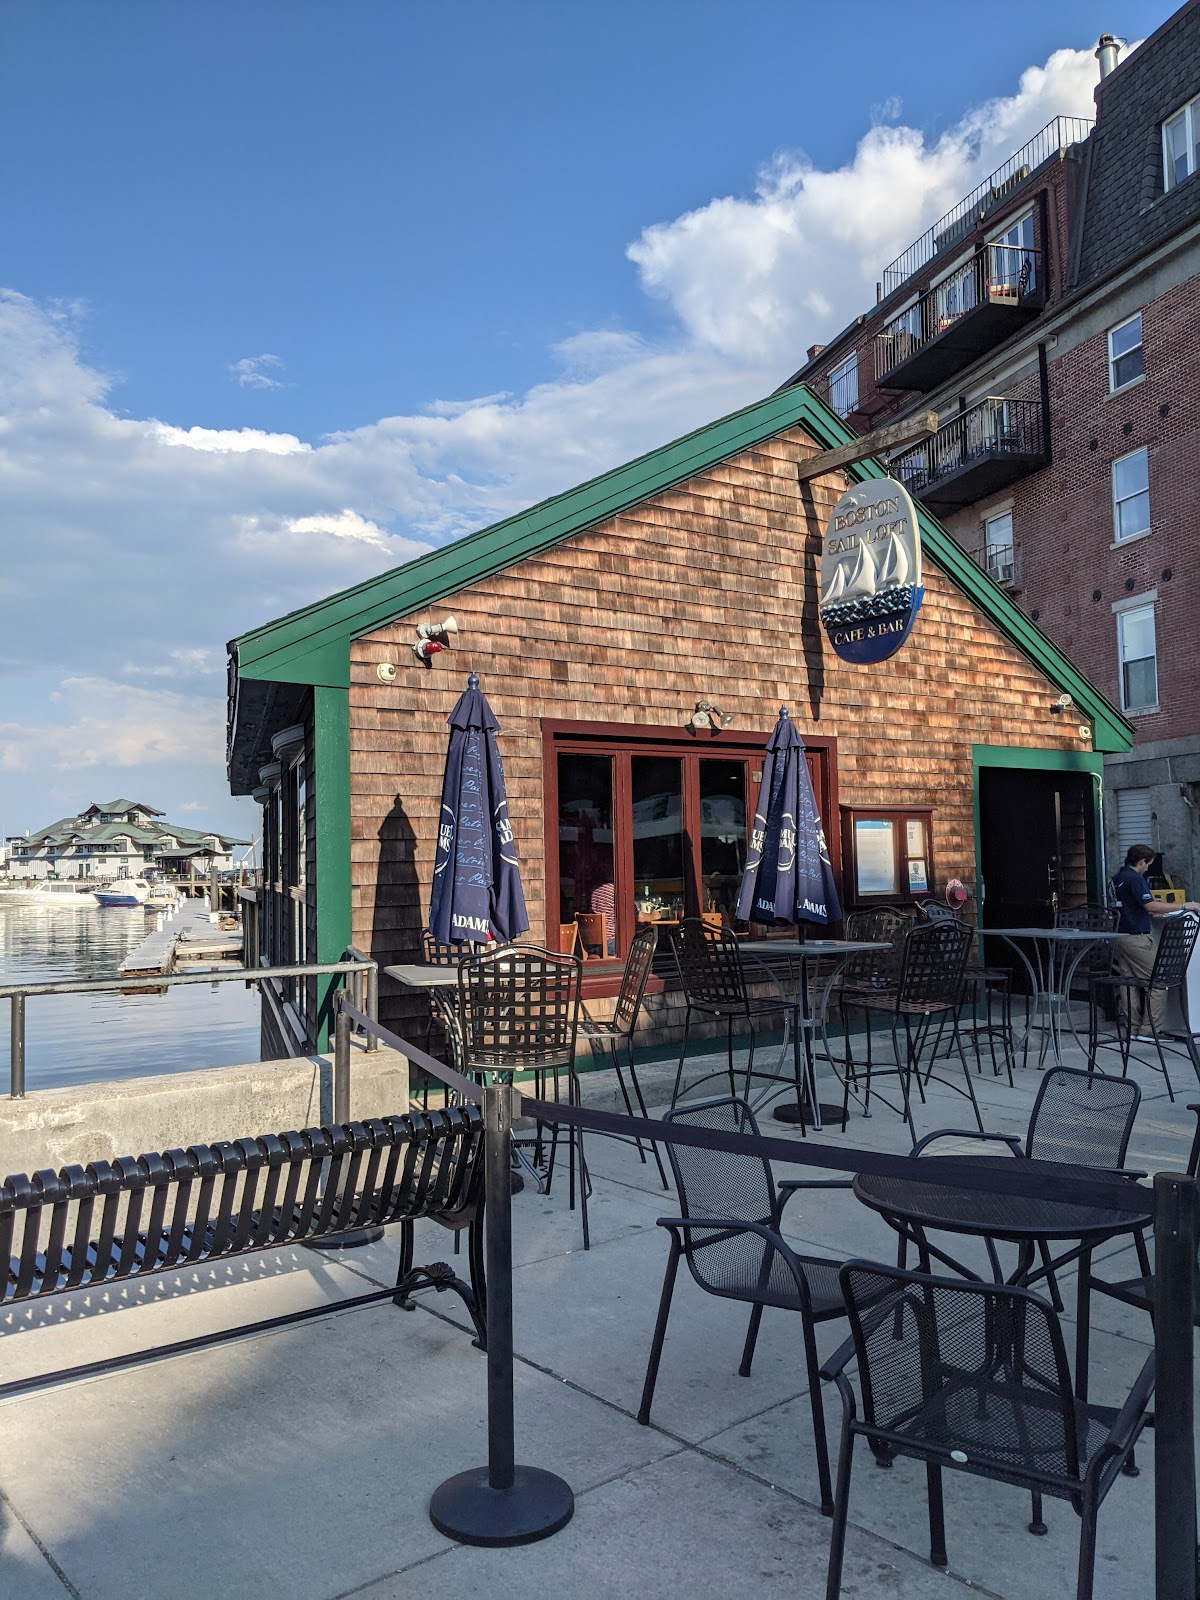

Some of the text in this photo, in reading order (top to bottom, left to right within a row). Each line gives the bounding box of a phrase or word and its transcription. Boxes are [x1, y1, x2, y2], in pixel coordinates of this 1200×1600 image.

[834, 496, 900, 533] BOSTON
[827, 517, 908, 557] SAIL LOFT
[834, 618, 904, 646] CAFE & BAR
